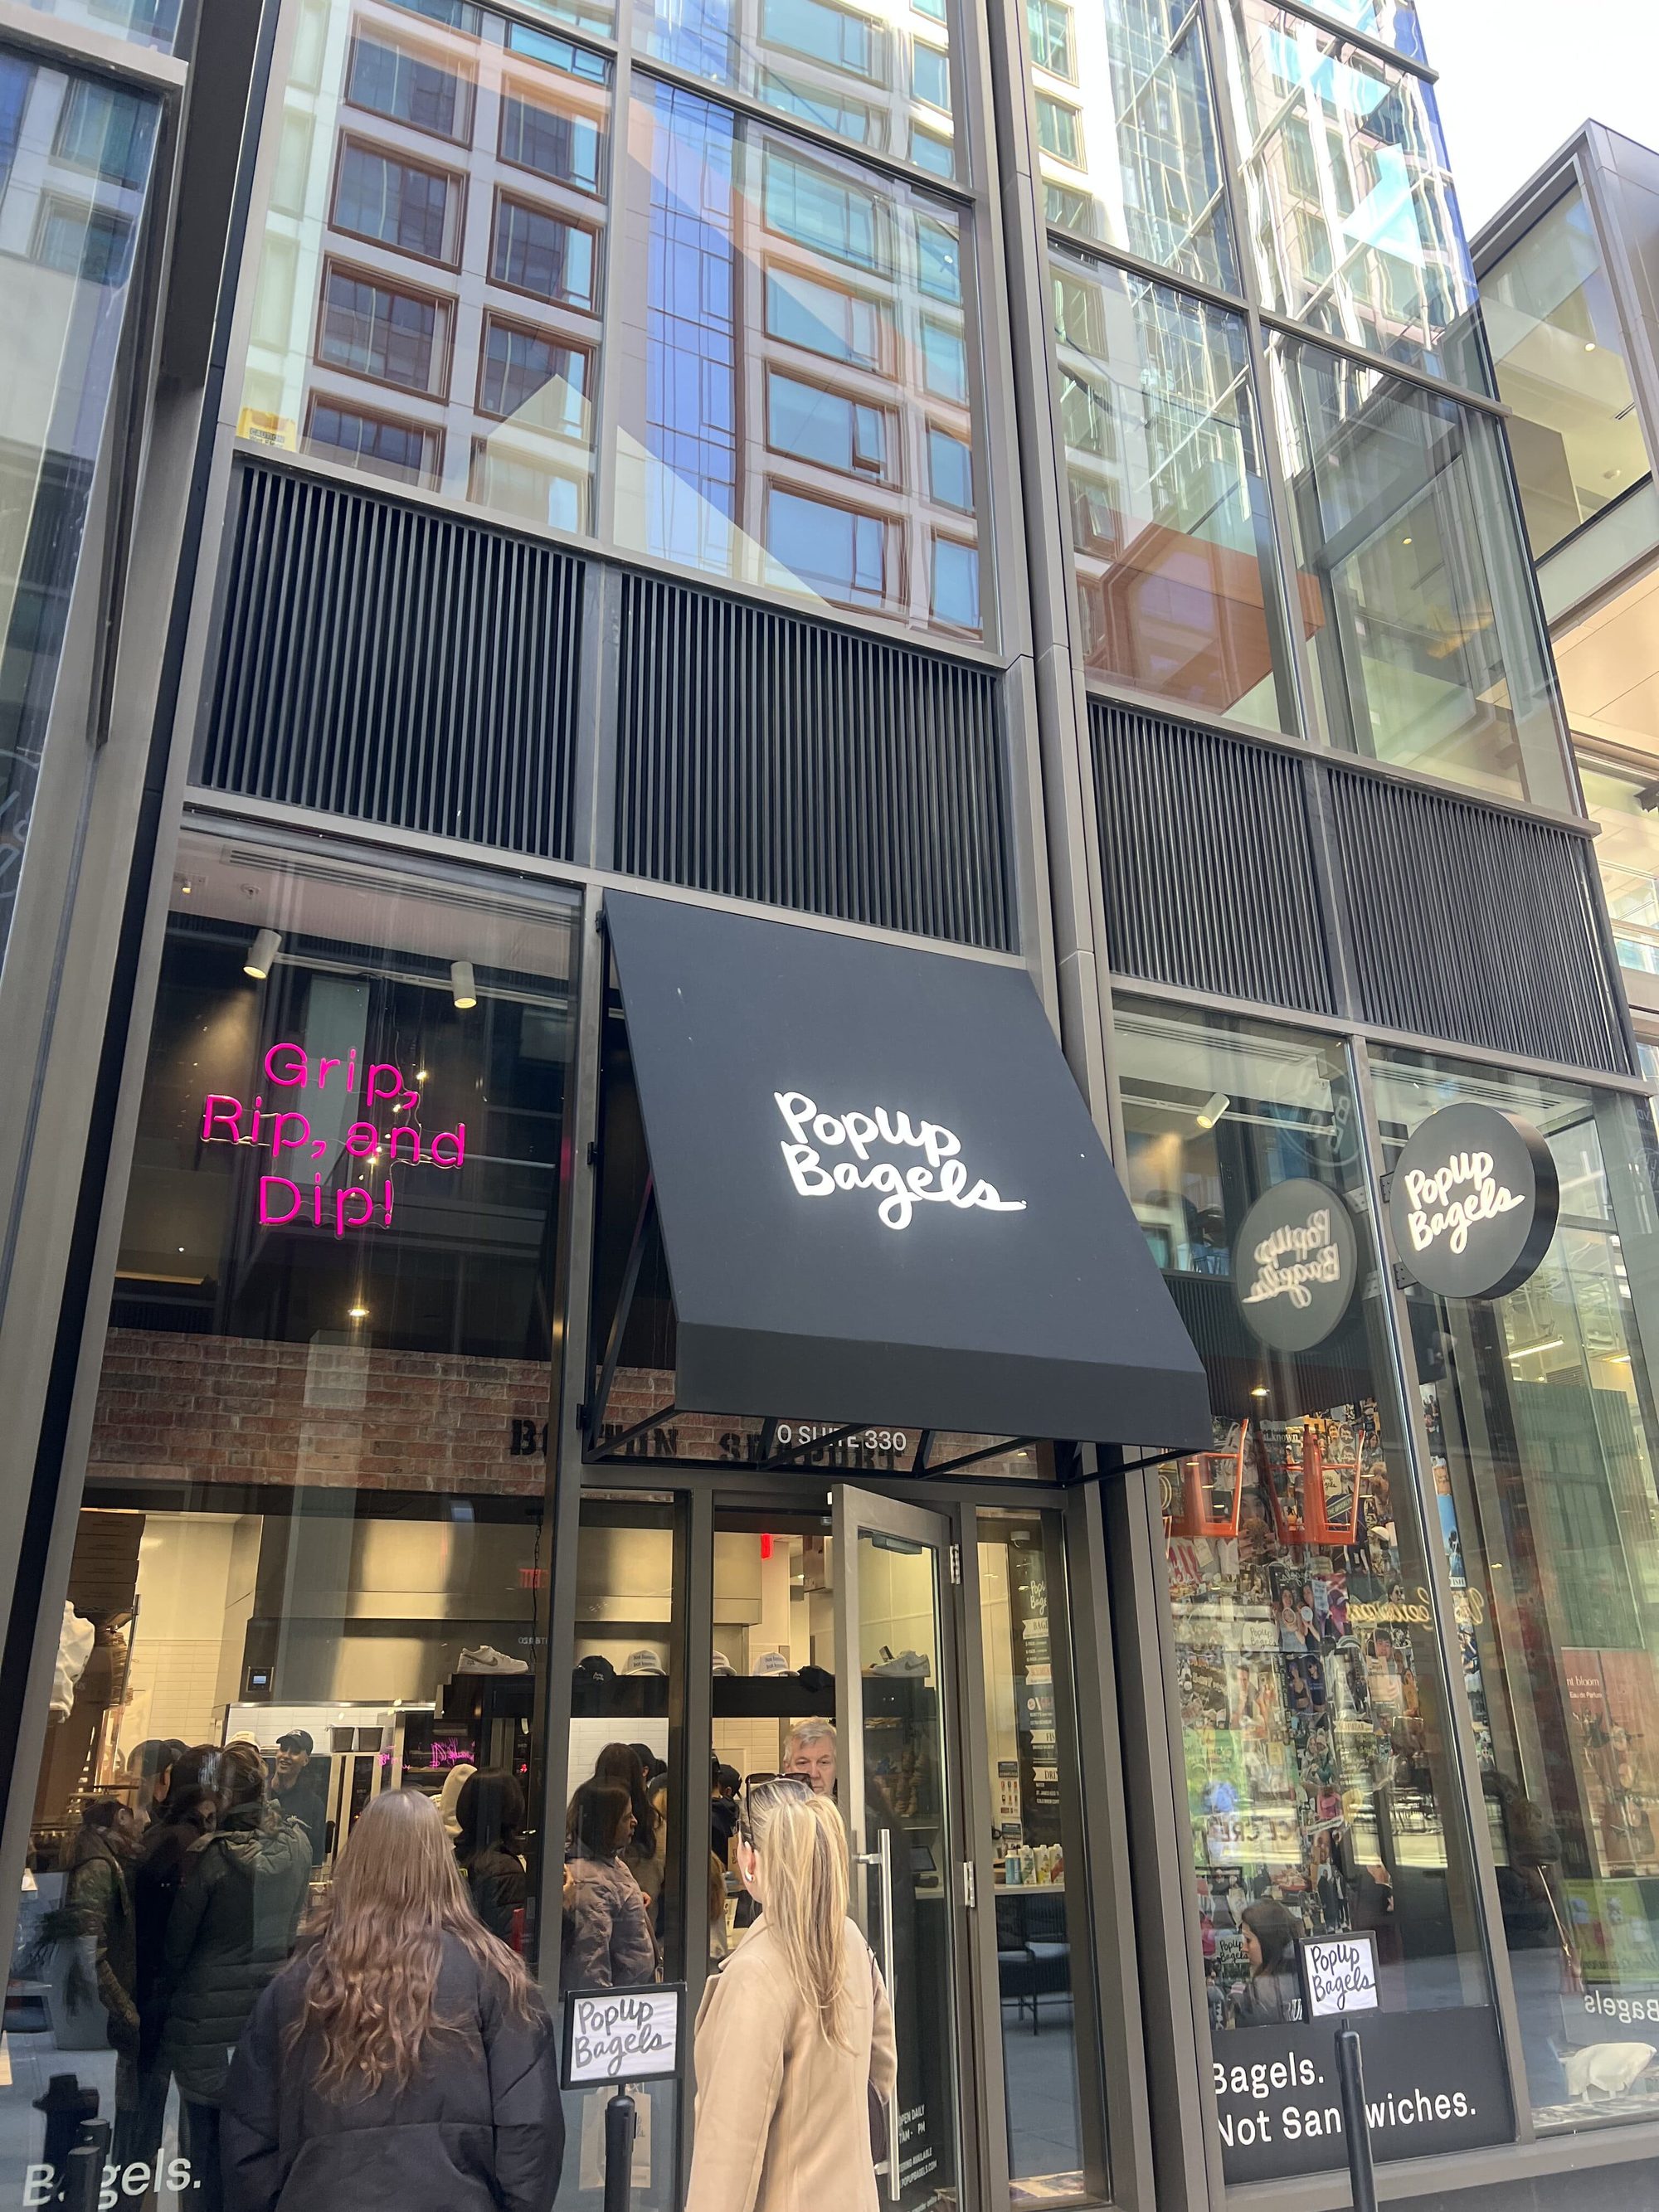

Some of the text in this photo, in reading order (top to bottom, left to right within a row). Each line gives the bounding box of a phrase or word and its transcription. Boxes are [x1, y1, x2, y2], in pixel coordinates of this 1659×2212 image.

[265, 1043, 419, 1110] Grip,
[202, 1094, 465, 1166] Rip, and
[260, 1172, 392, 1236] Dip!
[781, 1140, 1027, 1230] Bagels
[1407, 1178, 1526, 1255] Bagels
[865, 1429, 907, 1451] 330
[1575, 1675, 1600, 1686] bloom
[1312, 1966, 1376, 2010] Bagels
[575, 2024, 672, 2076] Bagels
[1213, 2051, 1325, 2099] Bagels.
[1218, 2088, 1477, 2147] Not Sanwiches.
[22, 2147, 201, 2210] Bgels.
